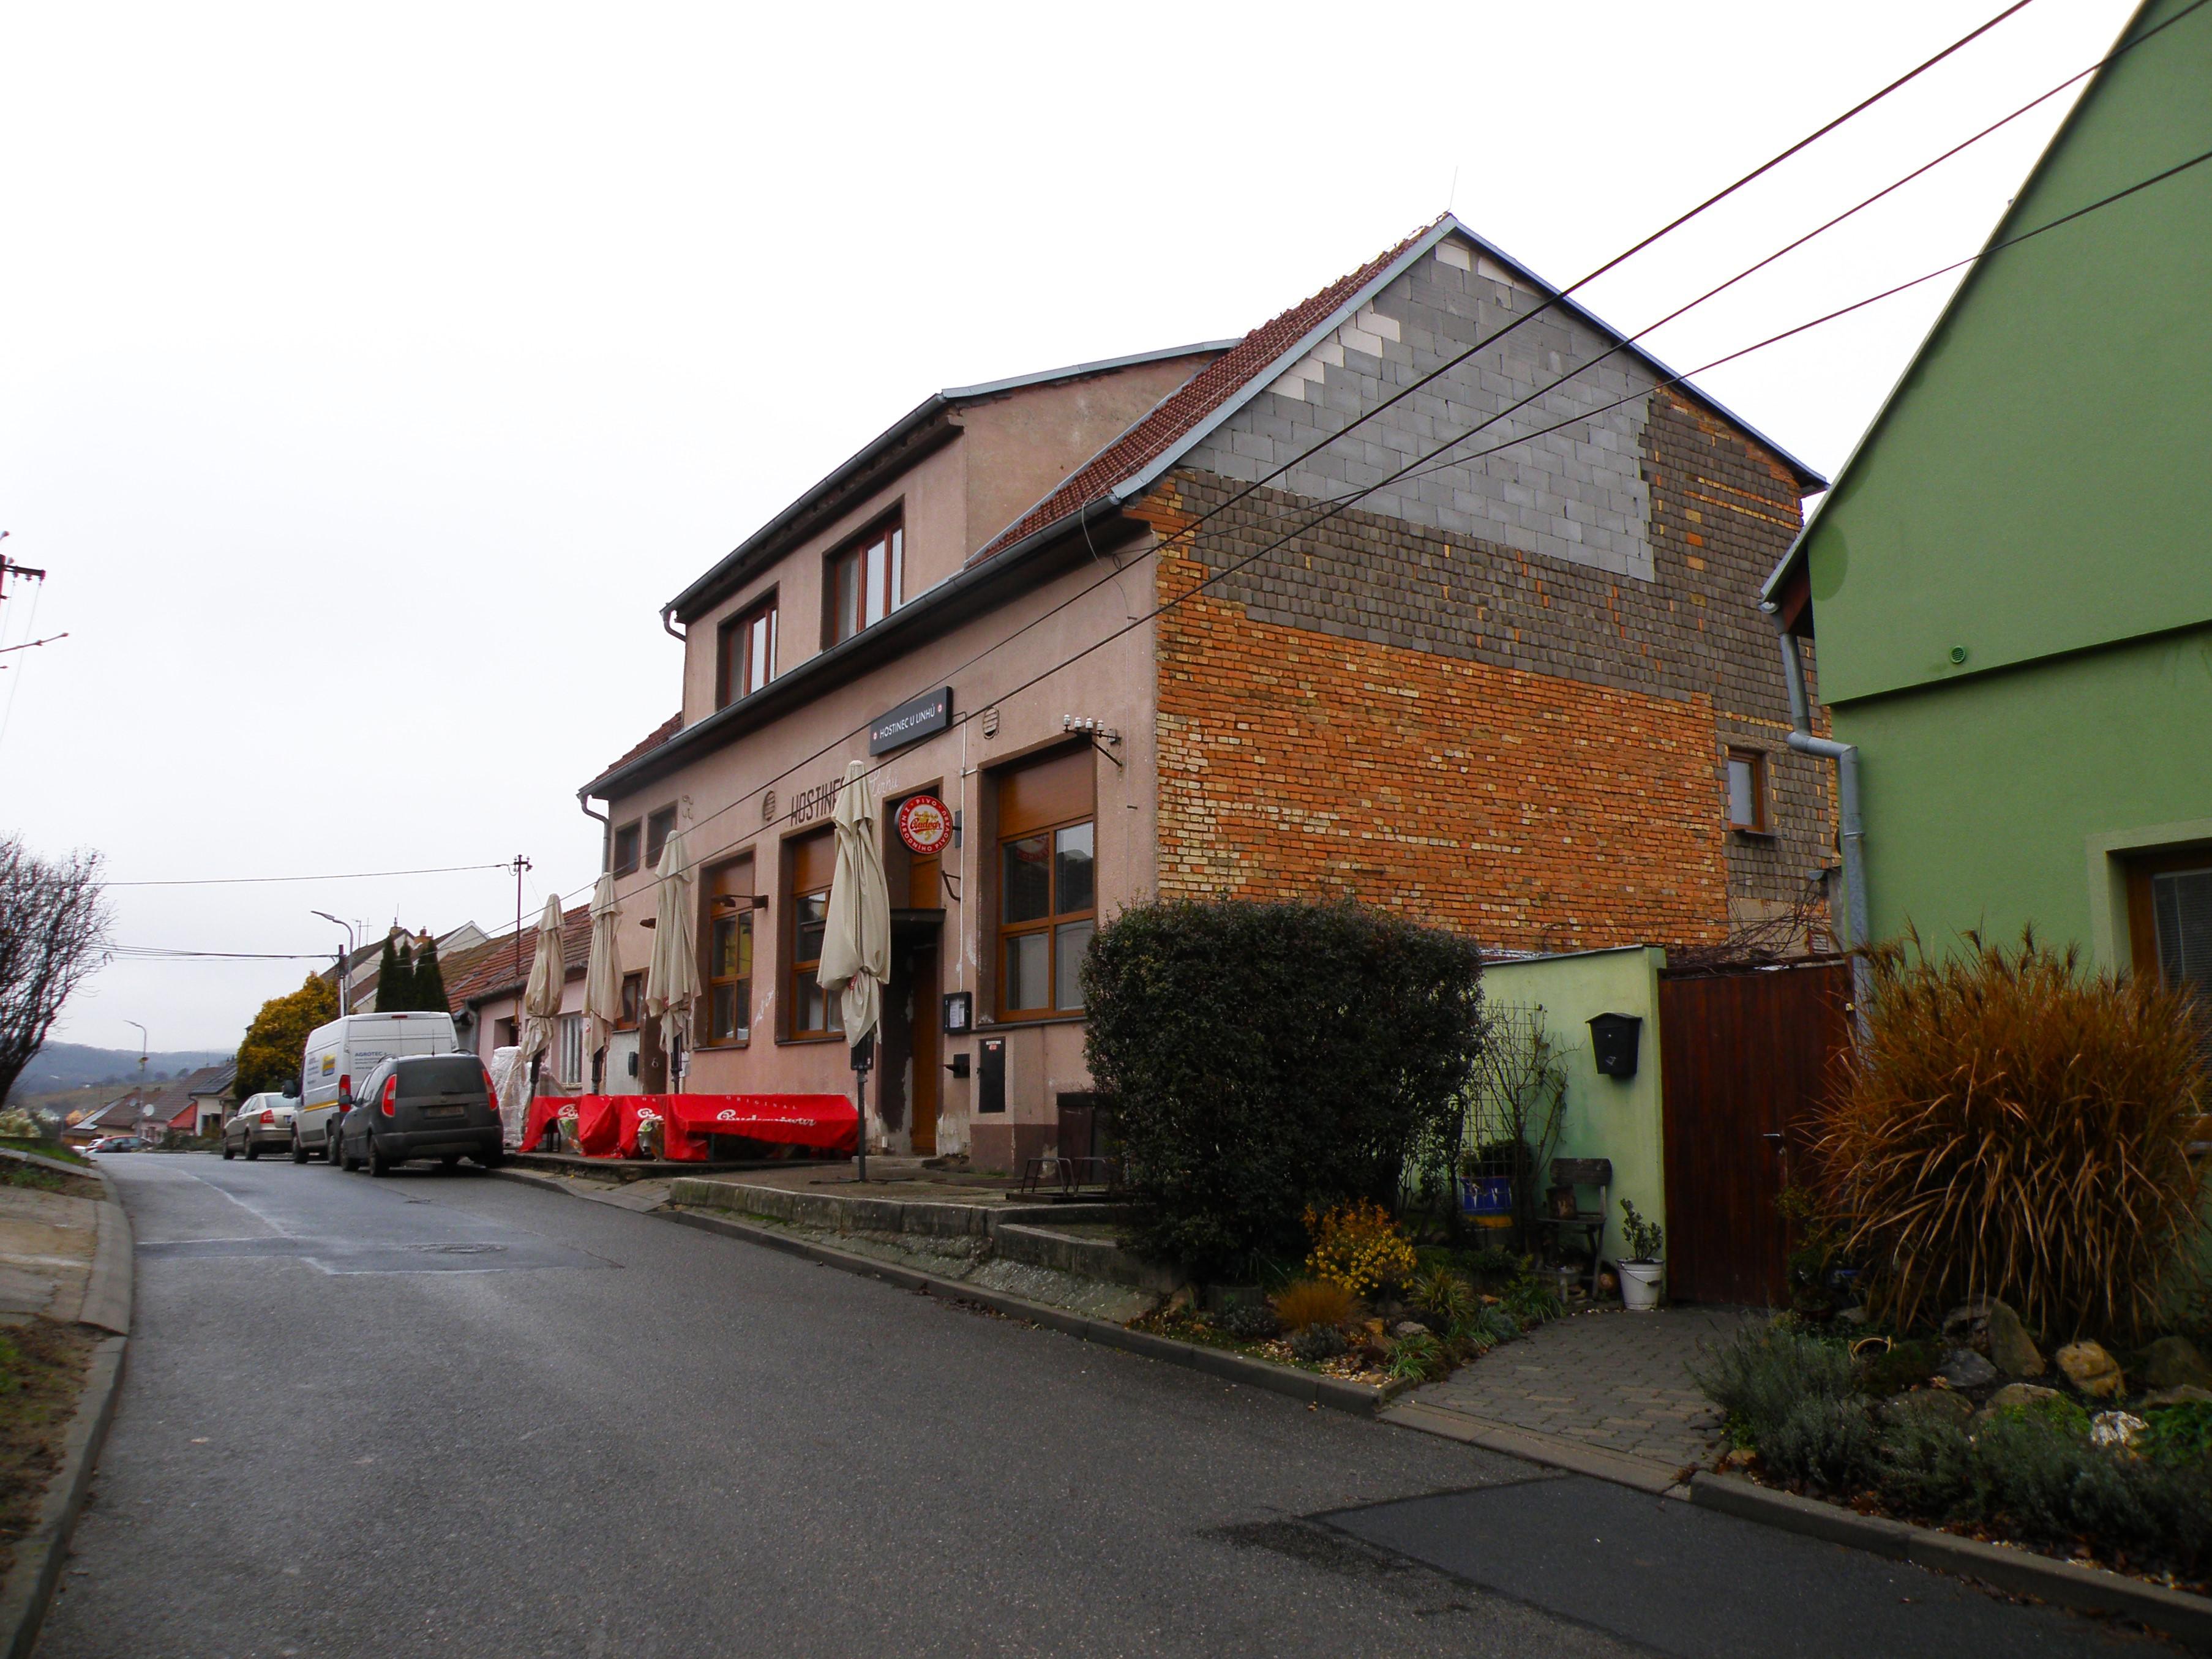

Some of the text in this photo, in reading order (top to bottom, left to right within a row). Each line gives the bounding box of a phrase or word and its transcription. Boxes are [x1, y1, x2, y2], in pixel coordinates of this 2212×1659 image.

[880, 717, 909, 739] HOSTINEC
[910, 716, 915, 726] U
[790, 776, 845, 826] HOSTINE
[915, 798, 937, 806] PIVO
[726, 1095, 797, 1110] ORIGINAL
